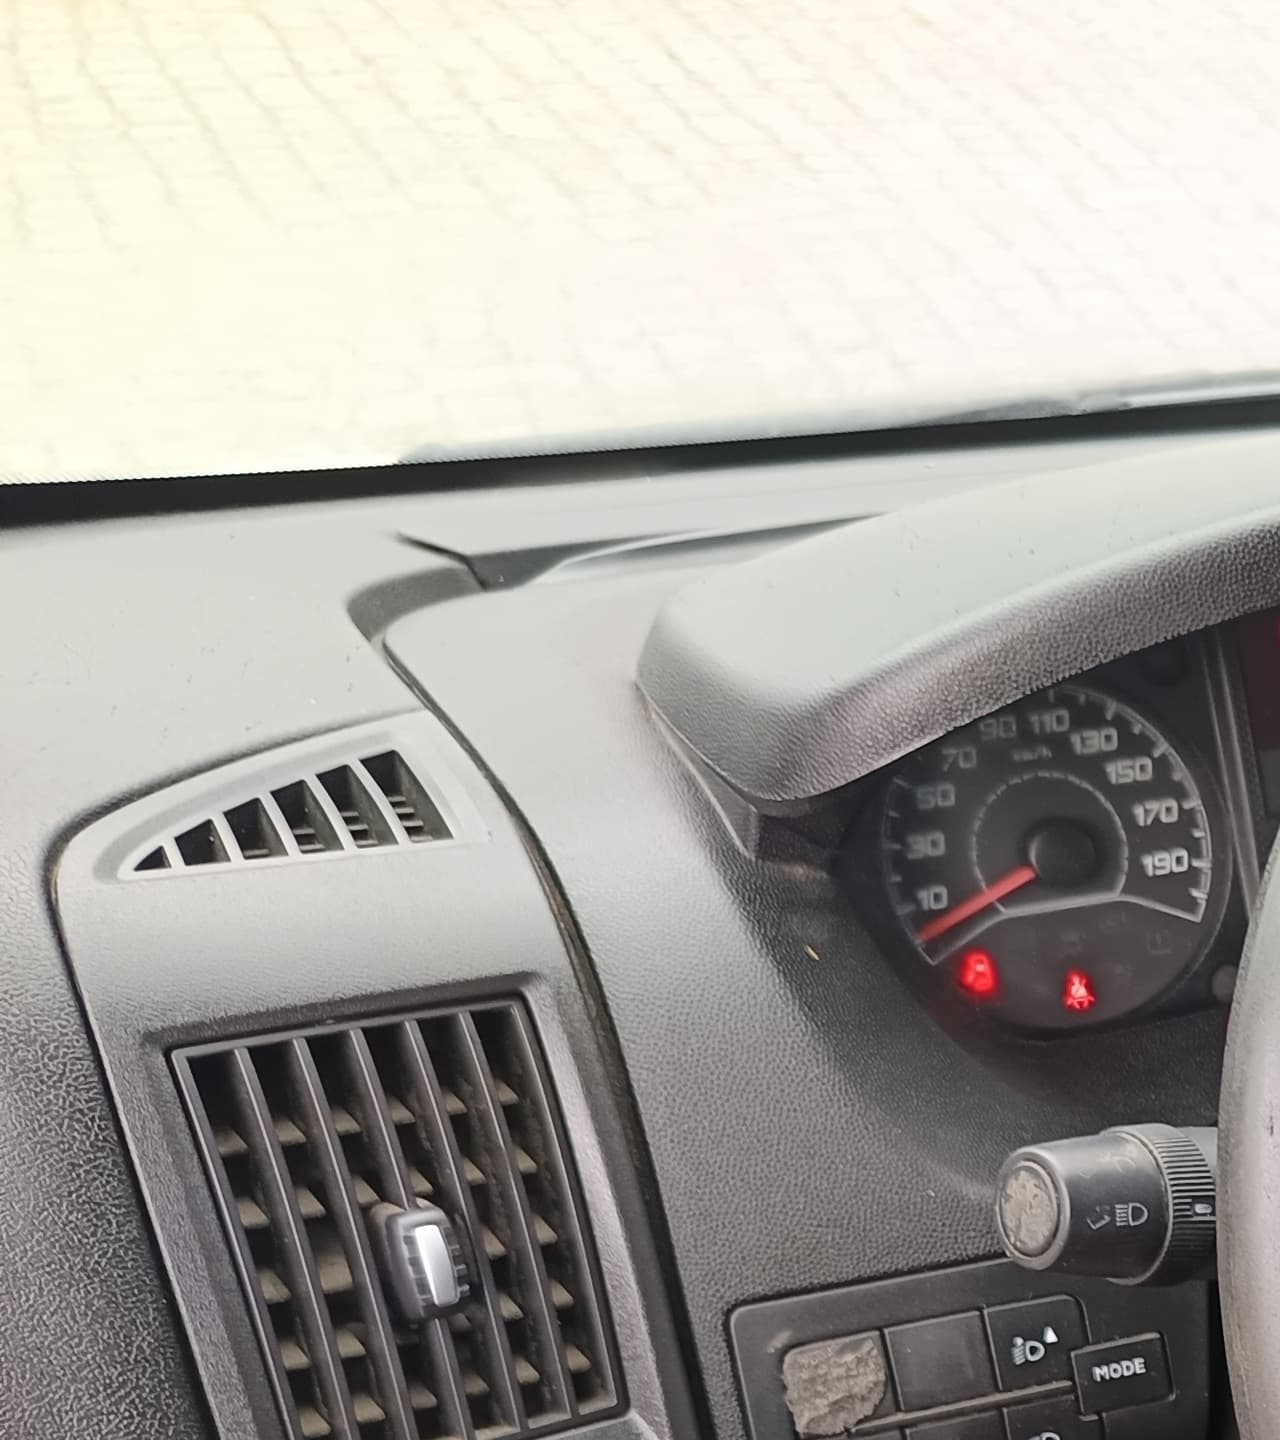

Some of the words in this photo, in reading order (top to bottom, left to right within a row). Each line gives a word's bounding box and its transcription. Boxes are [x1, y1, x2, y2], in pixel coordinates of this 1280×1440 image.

[980, 717, 1016, 740] 90
[1029, 710, 1069, 734] 110
[1070, 727, 1118, 755] 130
[942, 746, 976, 771] 70
[1105, 756, 1152, 784] 150
[917, 784, 955, 809] 50
[1133, 798, 1179, 827] 170
[907, 832, 945, 859] 30
[1142, 848, 1188, 877] 190
[918, 885, 948, 910] 10
[1091, 1356, 1146, 1382] MODE
